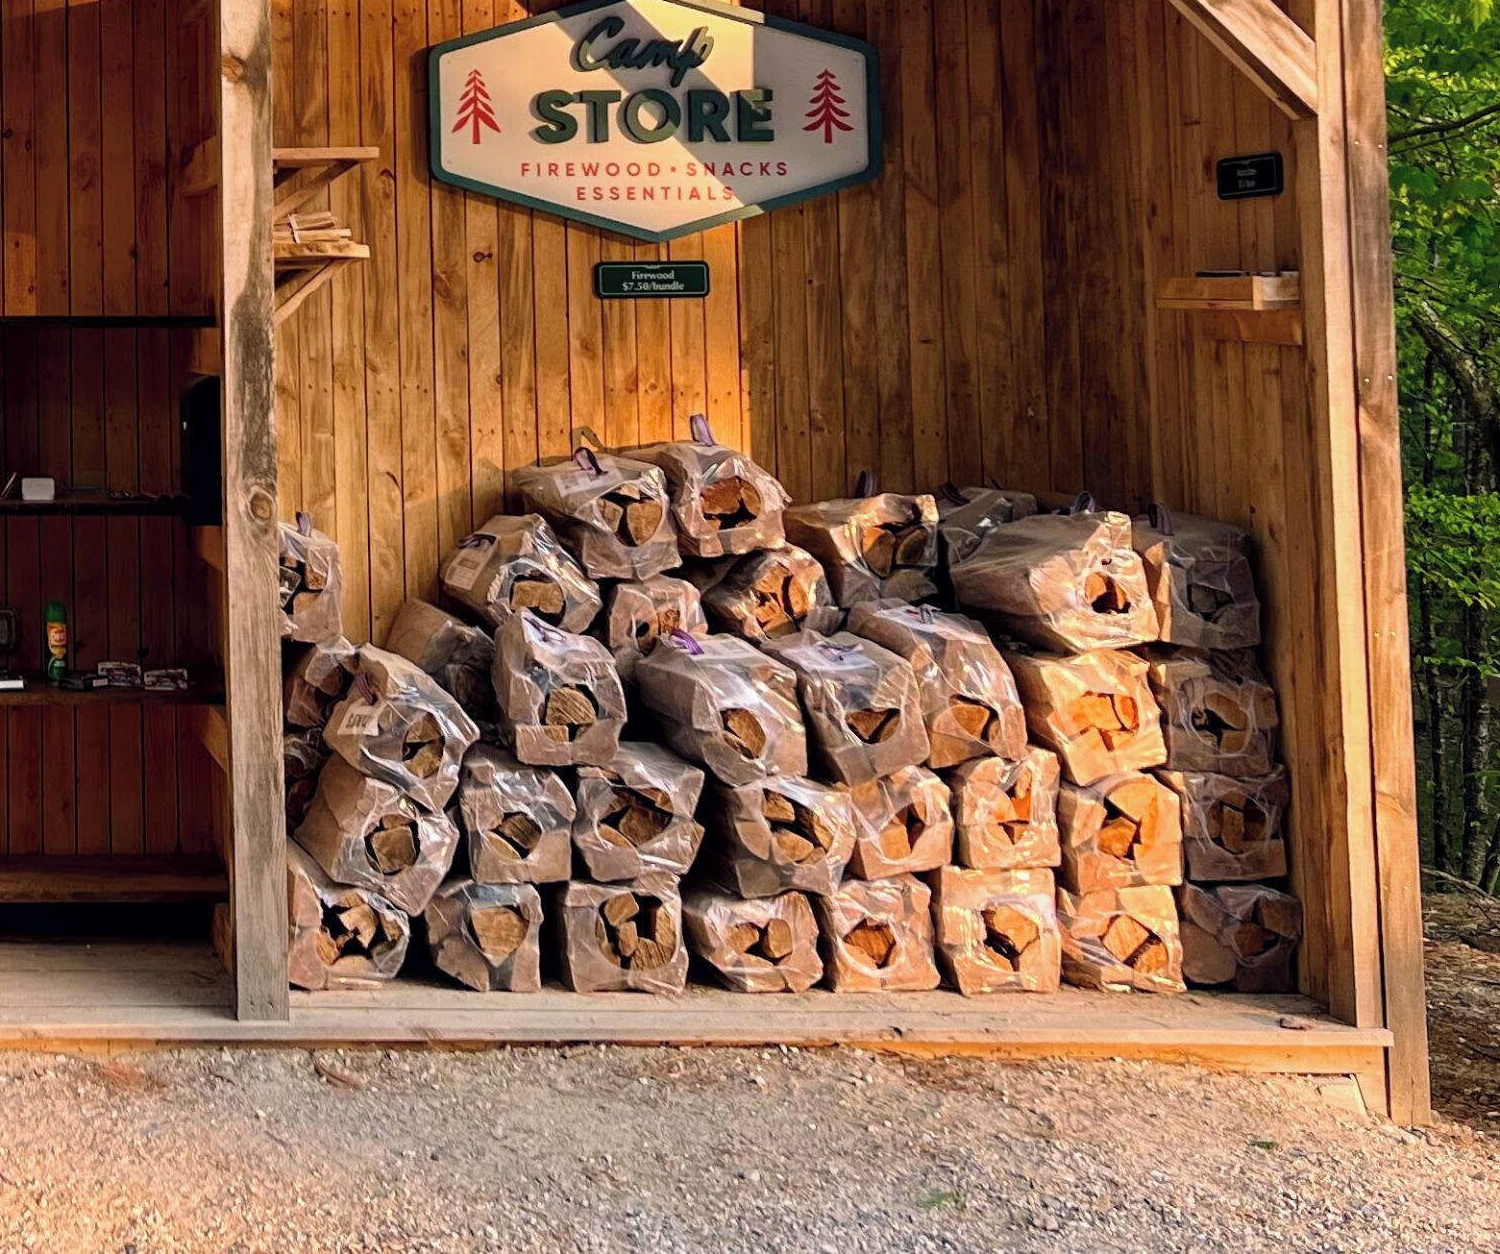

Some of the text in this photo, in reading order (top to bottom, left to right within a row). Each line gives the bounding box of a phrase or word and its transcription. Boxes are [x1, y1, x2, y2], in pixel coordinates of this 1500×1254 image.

[574, 16, 714, 87] Camp
[534, 88, 774, 144] STORE
[520, 161, 788, 177] FIREWOOD SNACKS
[577, 186, 734, 201] ESSENTIALS
[631, 270, 675, 280] Firewood
[622, 281, 685, 291] $7.50/bundle
